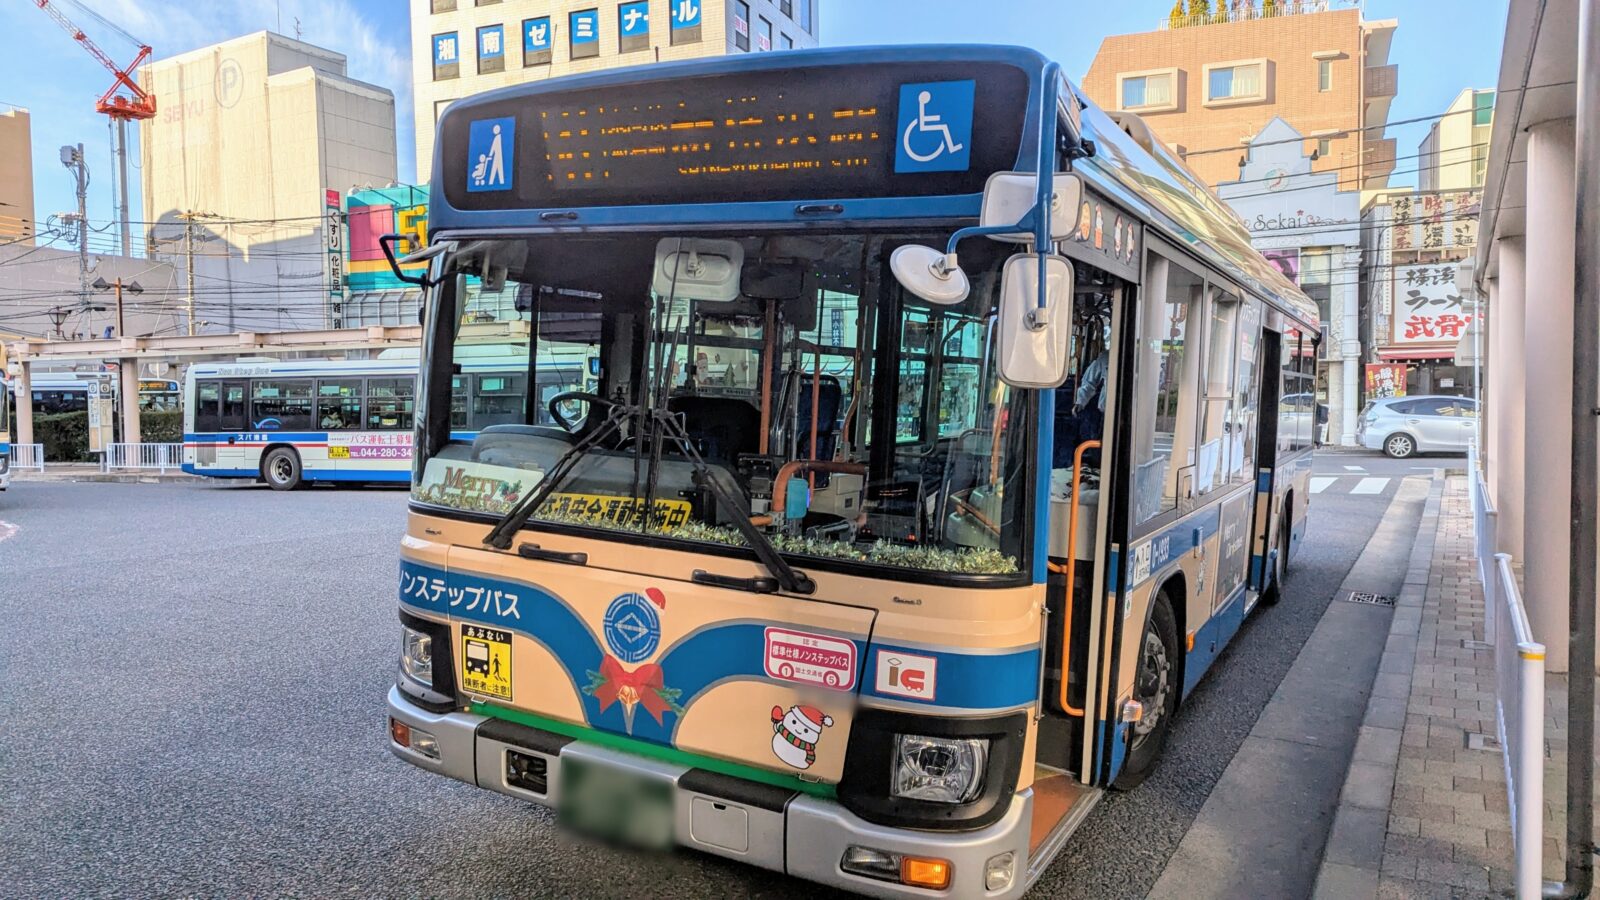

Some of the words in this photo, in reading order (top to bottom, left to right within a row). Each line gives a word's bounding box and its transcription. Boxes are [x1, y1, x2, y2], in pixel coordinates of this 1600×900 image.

[163, 99, 204, 124] SEIYU
[330, 212, 338, 248] くすり
[1253, 210, 1304, 231] Sekai
[331, 255, 340, 291] 化粧品
[443, 466, 503, 499] Merry
[399, 570, 521, 619] ノンステップバス
[467, 627, 504, 642] あぶない
[772, 645, 848, 667] 標準仕様ノンステップバス
